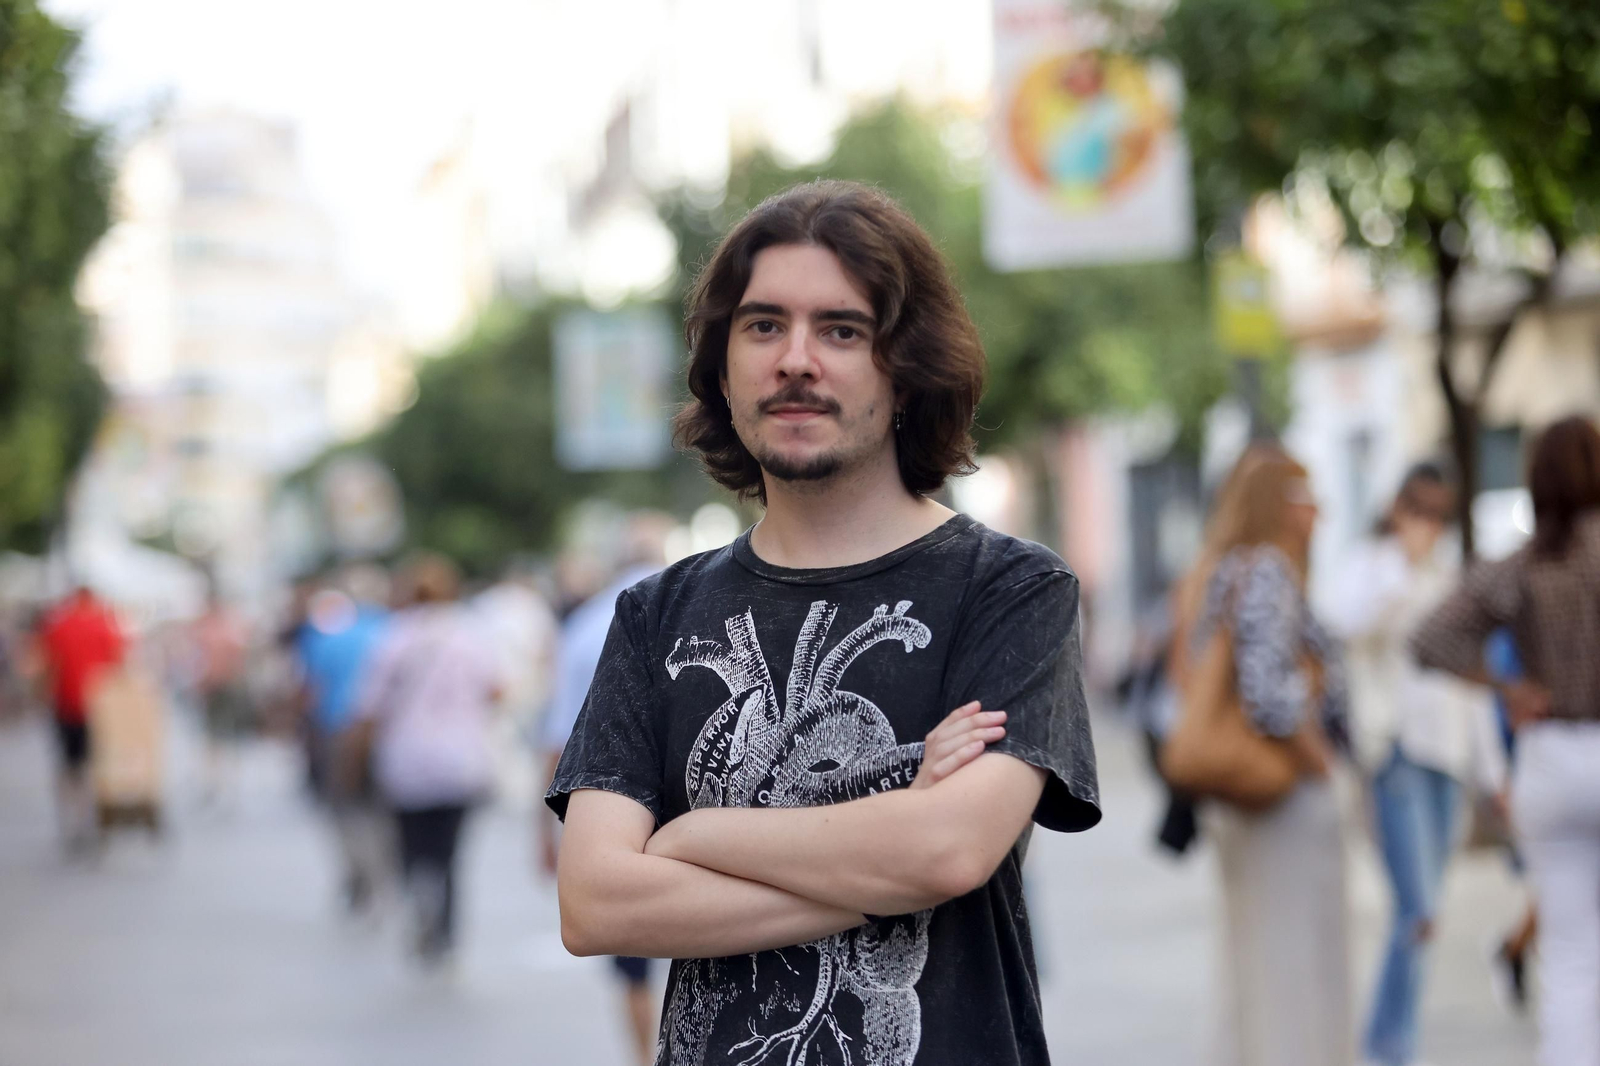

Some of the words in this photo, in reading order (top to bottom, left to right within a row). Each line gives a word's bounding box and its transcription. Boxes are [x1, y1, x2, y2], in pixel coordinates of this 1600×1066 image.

[690, 701, 739, 790] SUPERIOR
[707, 731, 735, 768] VENA
[719, 757, 735, 788] CAVA
[868, 767, 917, 796] ARTE
